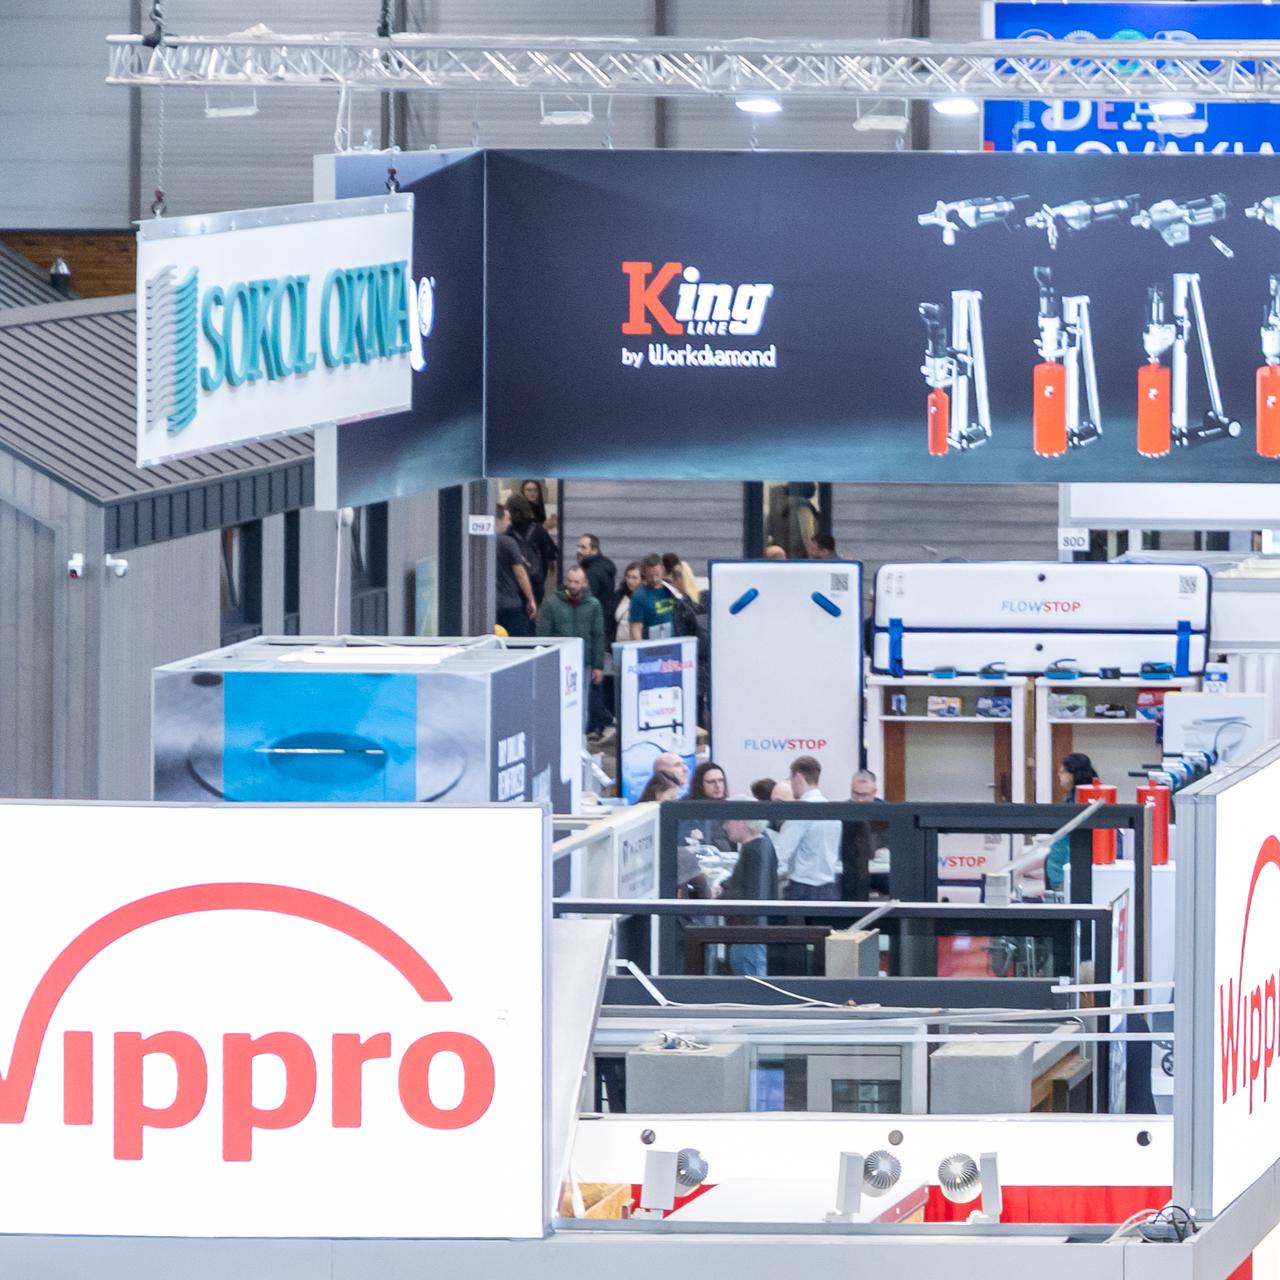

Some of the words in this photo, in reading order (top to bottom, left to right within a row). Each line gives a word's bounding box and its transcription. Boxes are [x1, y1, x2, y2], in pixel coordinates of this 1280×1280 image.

[621, 261, 775, 336] King
[200, 274, 317, 392] SOKOL
[320, 259, 412, 368] OKNA
[686, 321, 729, 336] LINE
[621, 347, 645, 369] by
[648, 343, 778, 368] Workdiamond
[1001, 600, 1081, 613] FLOWSTOP
[744, 738, 828, 752] FLOWSTOP
